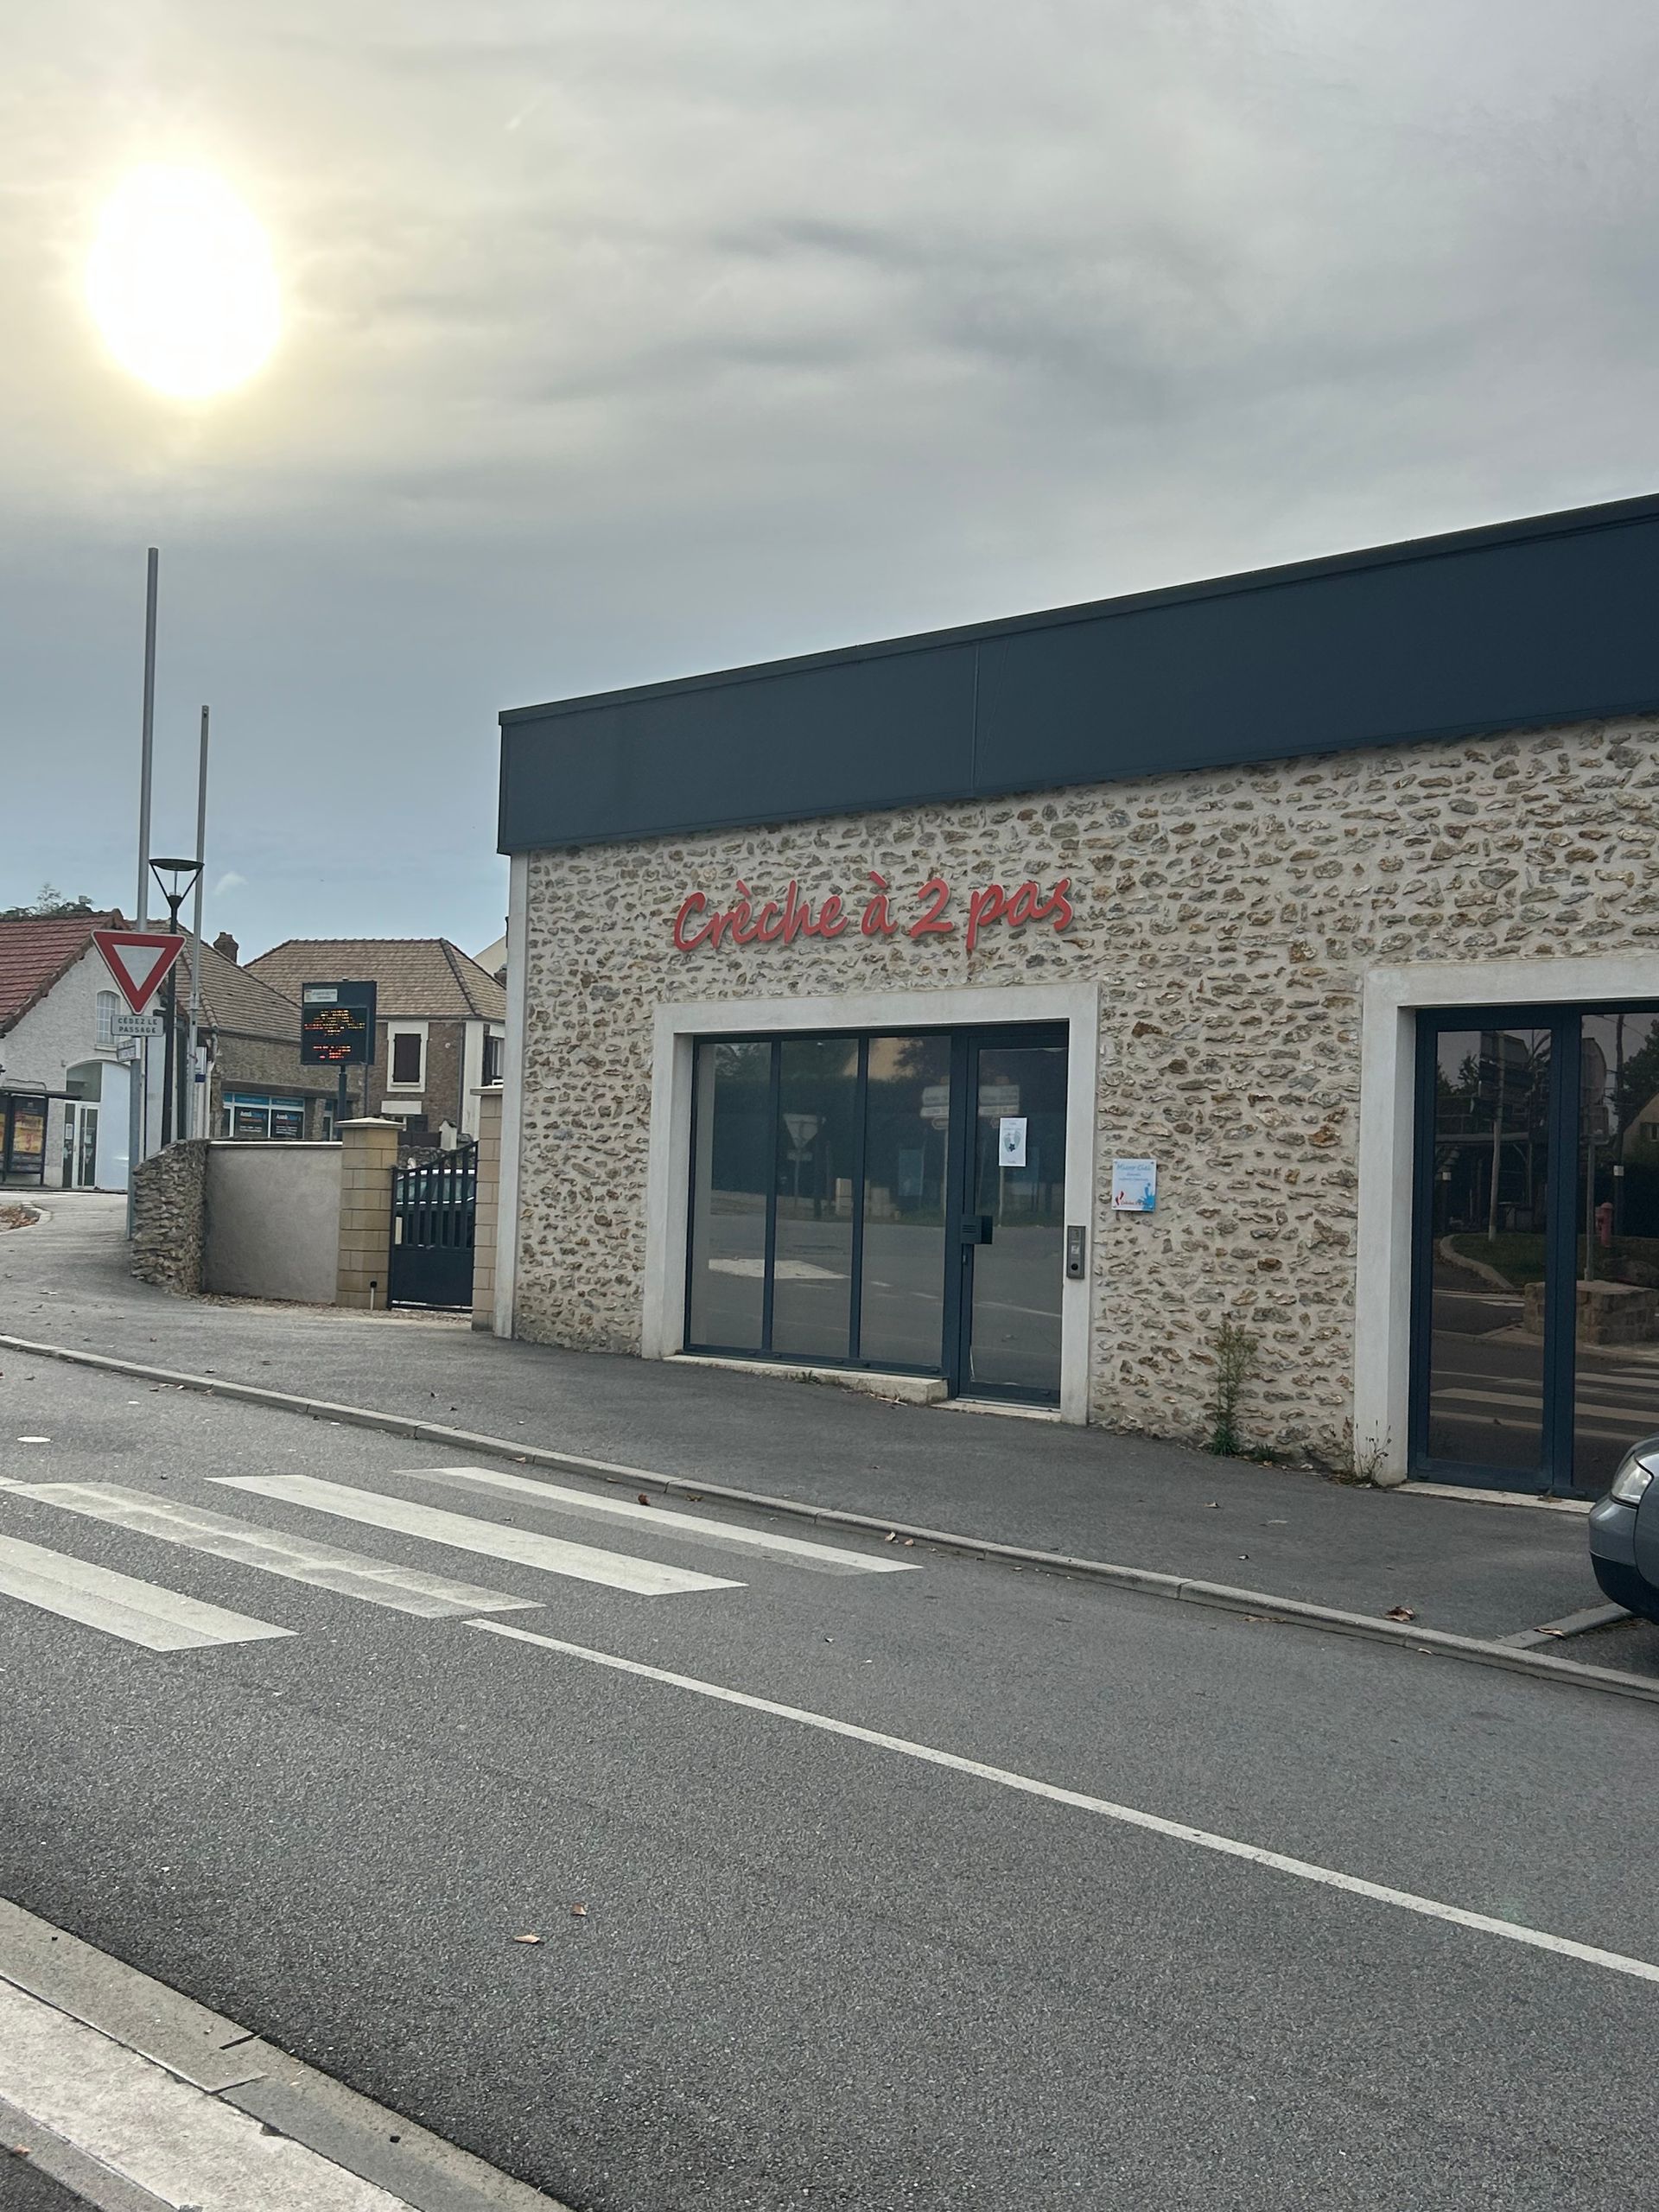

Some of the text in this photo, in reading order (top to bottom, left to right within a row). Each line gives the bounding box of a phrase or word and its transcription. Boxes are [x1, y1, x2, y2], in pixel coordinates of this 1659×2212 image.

[673, 870, 1074, 951] Crèche à 2 pas
